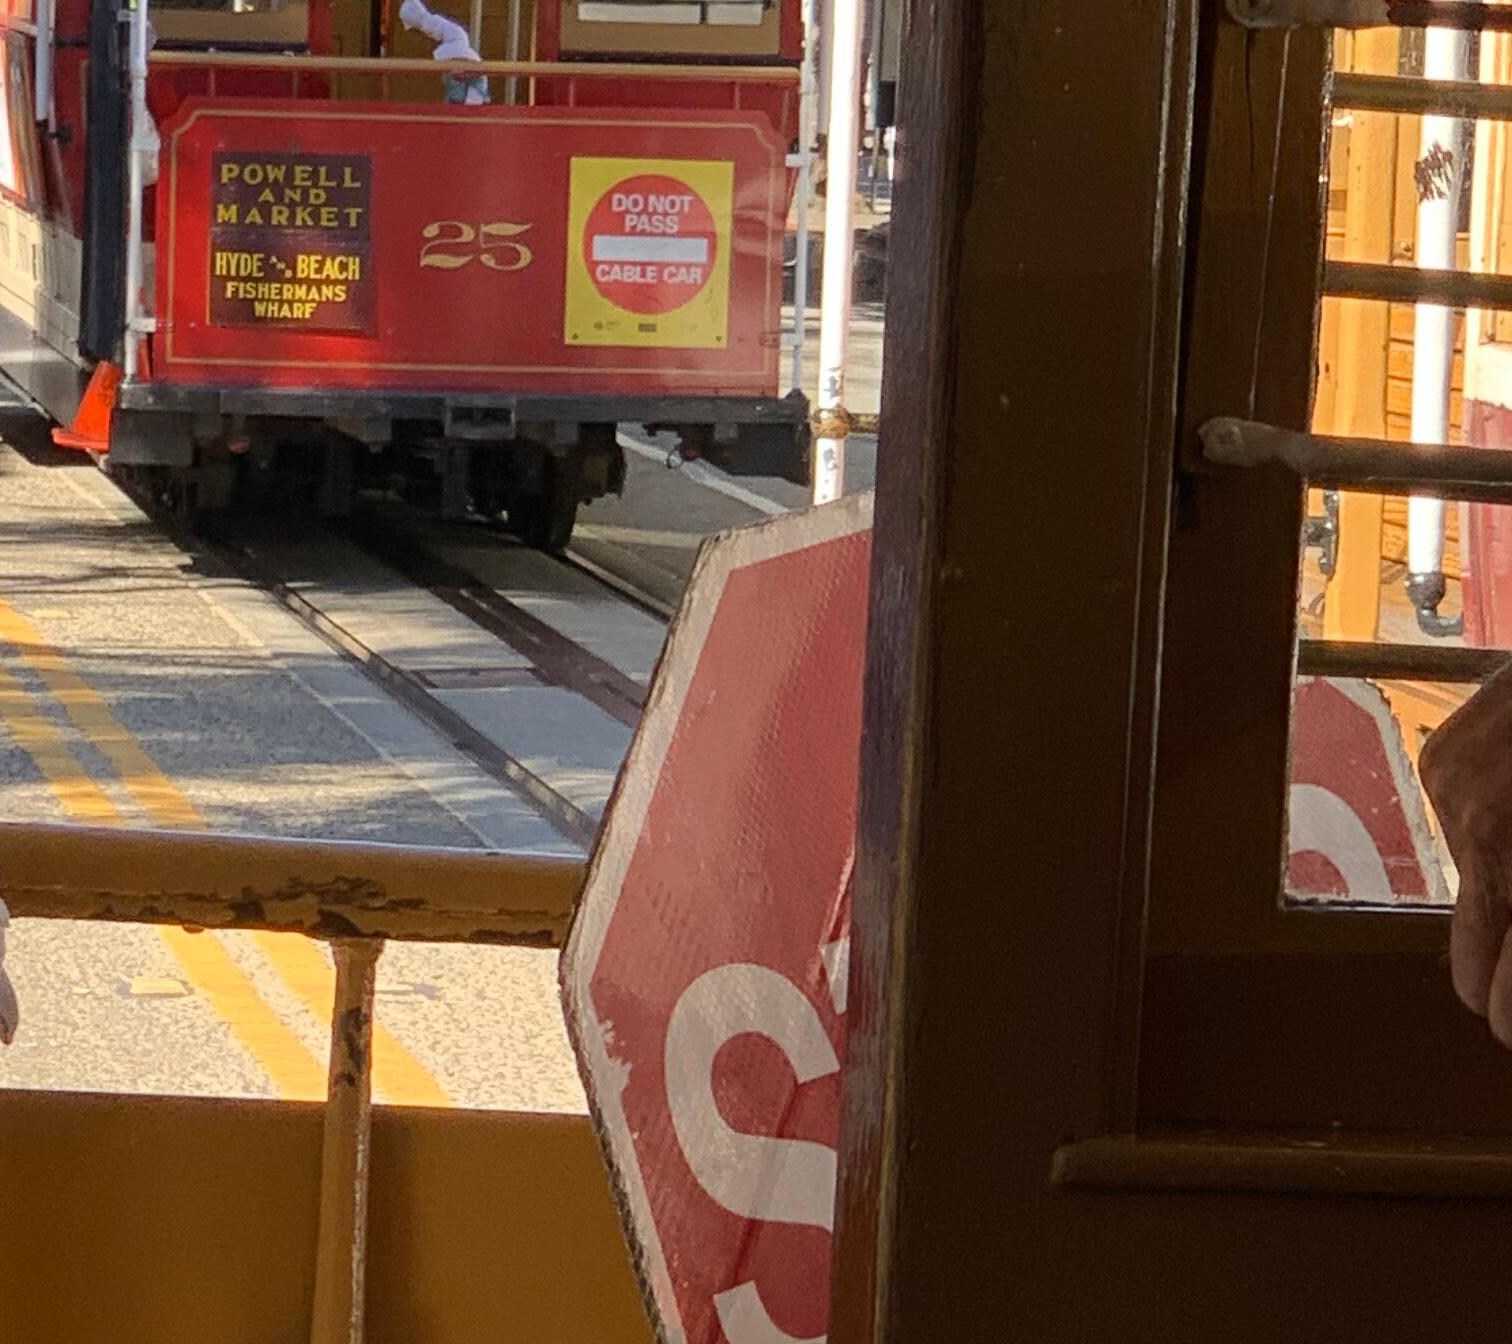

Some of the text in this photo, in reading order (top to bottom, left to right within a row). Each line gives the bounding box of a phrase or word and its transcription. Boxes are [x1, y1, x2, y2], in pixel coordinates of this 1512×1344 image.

[220, 163, 362, 188] POWELL
[257, 188, 328, 204] AND
[611, 193, 695, 214] DO NOT
[216, 204, 363, 228] MARKET
[624, 214, 680, 233] PASS
[420, 220, 534, 271] 25
[215, 252, 360, 281] HYDE AND BEACH
[595, 264, 703, 285] CABLE CAR
[225, 281, 347, 302] FISHERMANS
[254, 301, 318, 319] WHARF
